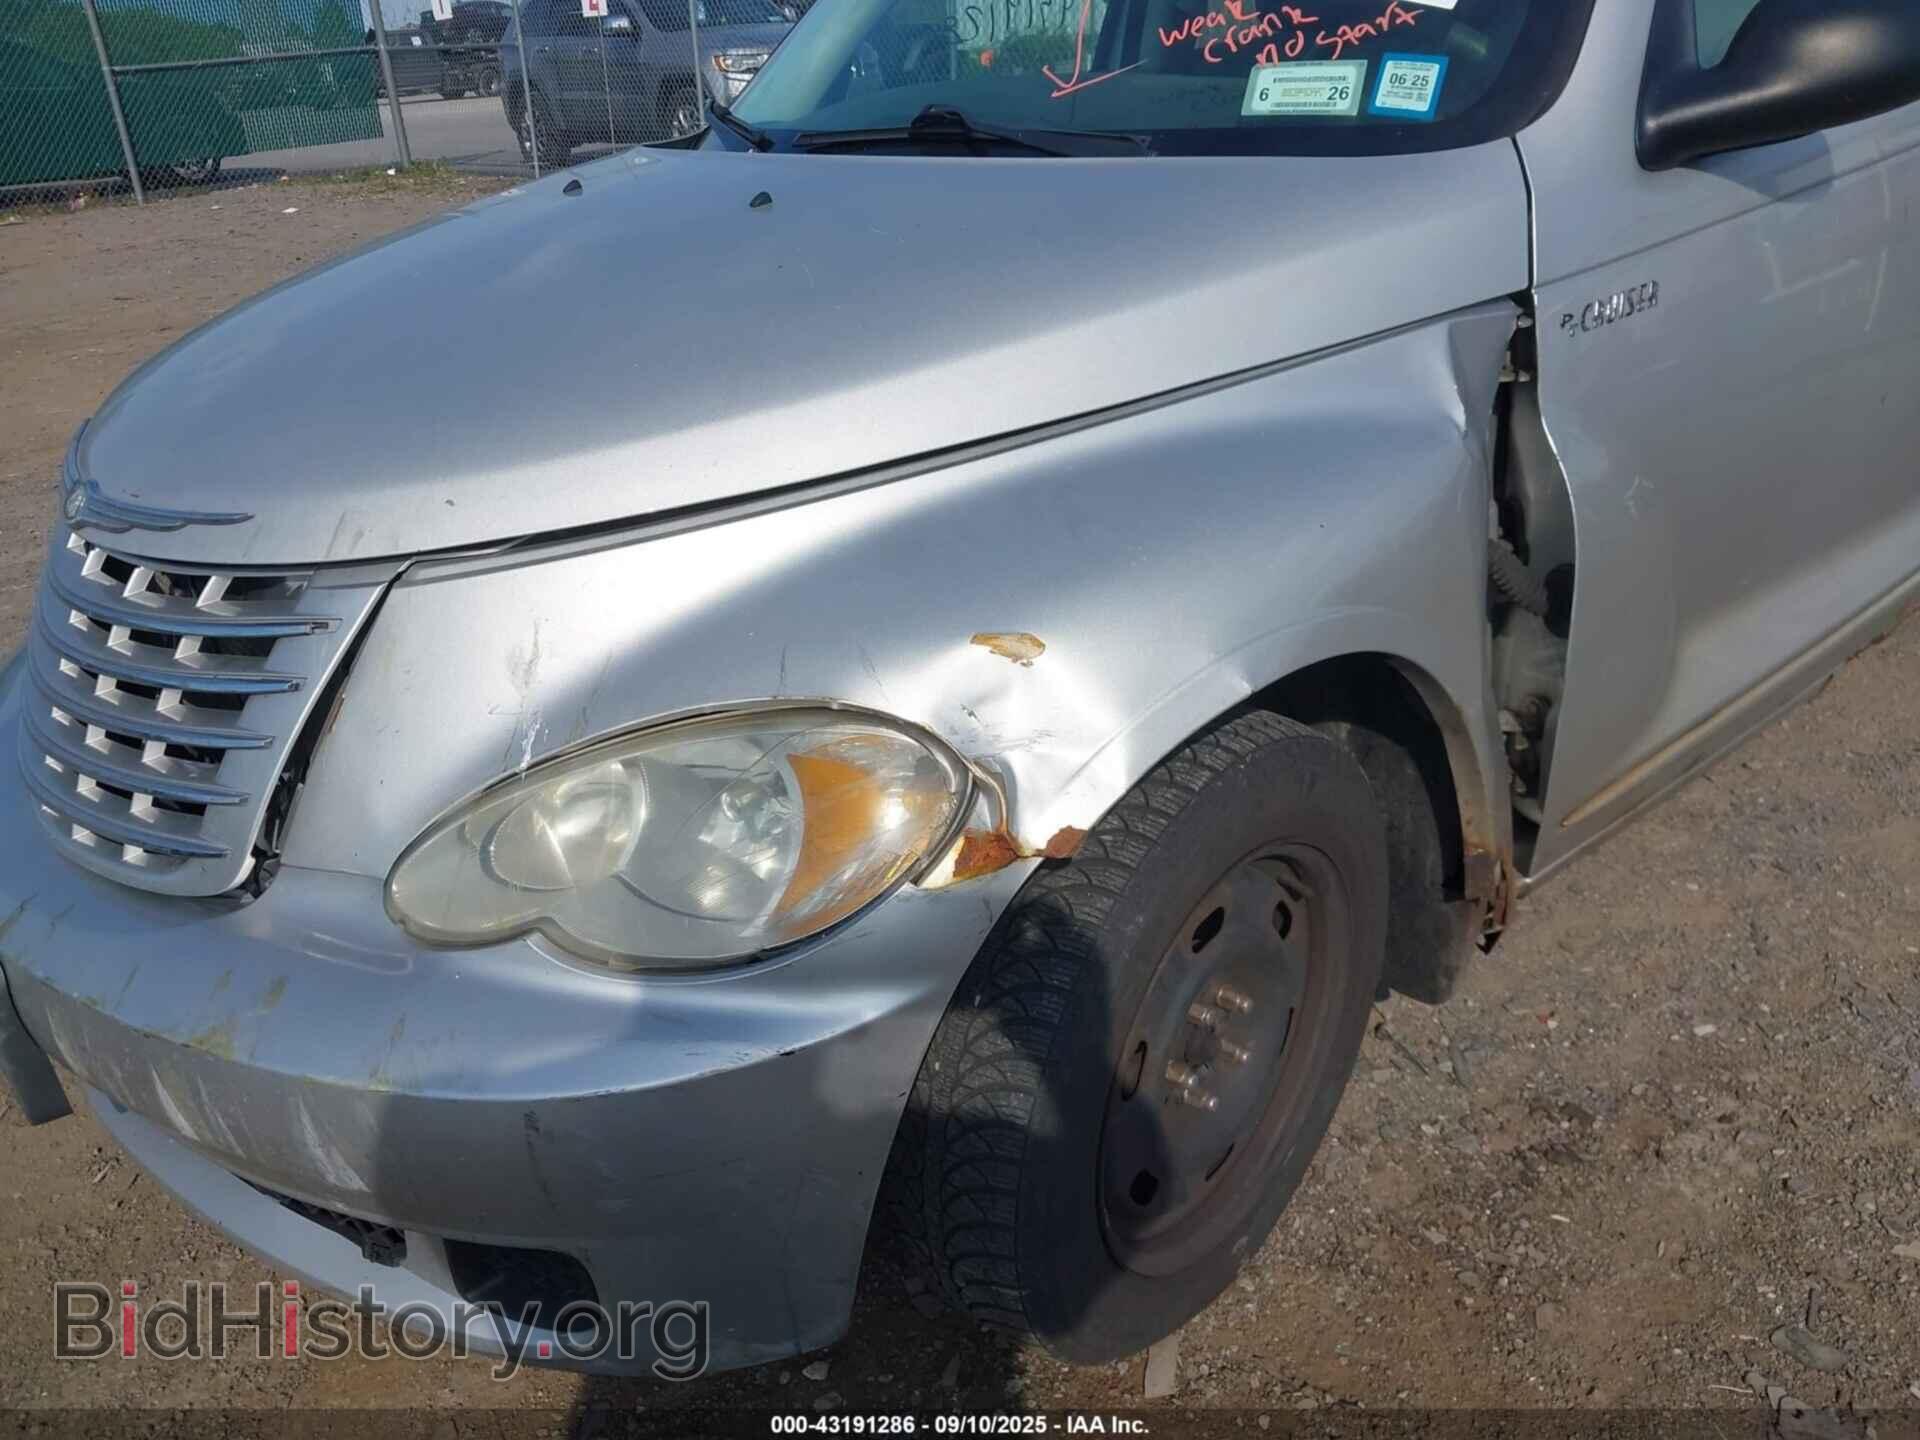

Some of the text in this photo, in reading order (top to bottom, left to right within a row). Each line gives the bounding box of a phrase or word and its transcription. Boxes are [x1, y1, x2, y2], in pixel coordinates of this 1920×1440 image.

[1389, 72, 1430, 87] 06 25
[1259, 87, 1270, 102] 6
[1327, 86, 1350, 101] 26
[1580, 280, 1660, 332] CRUISER
